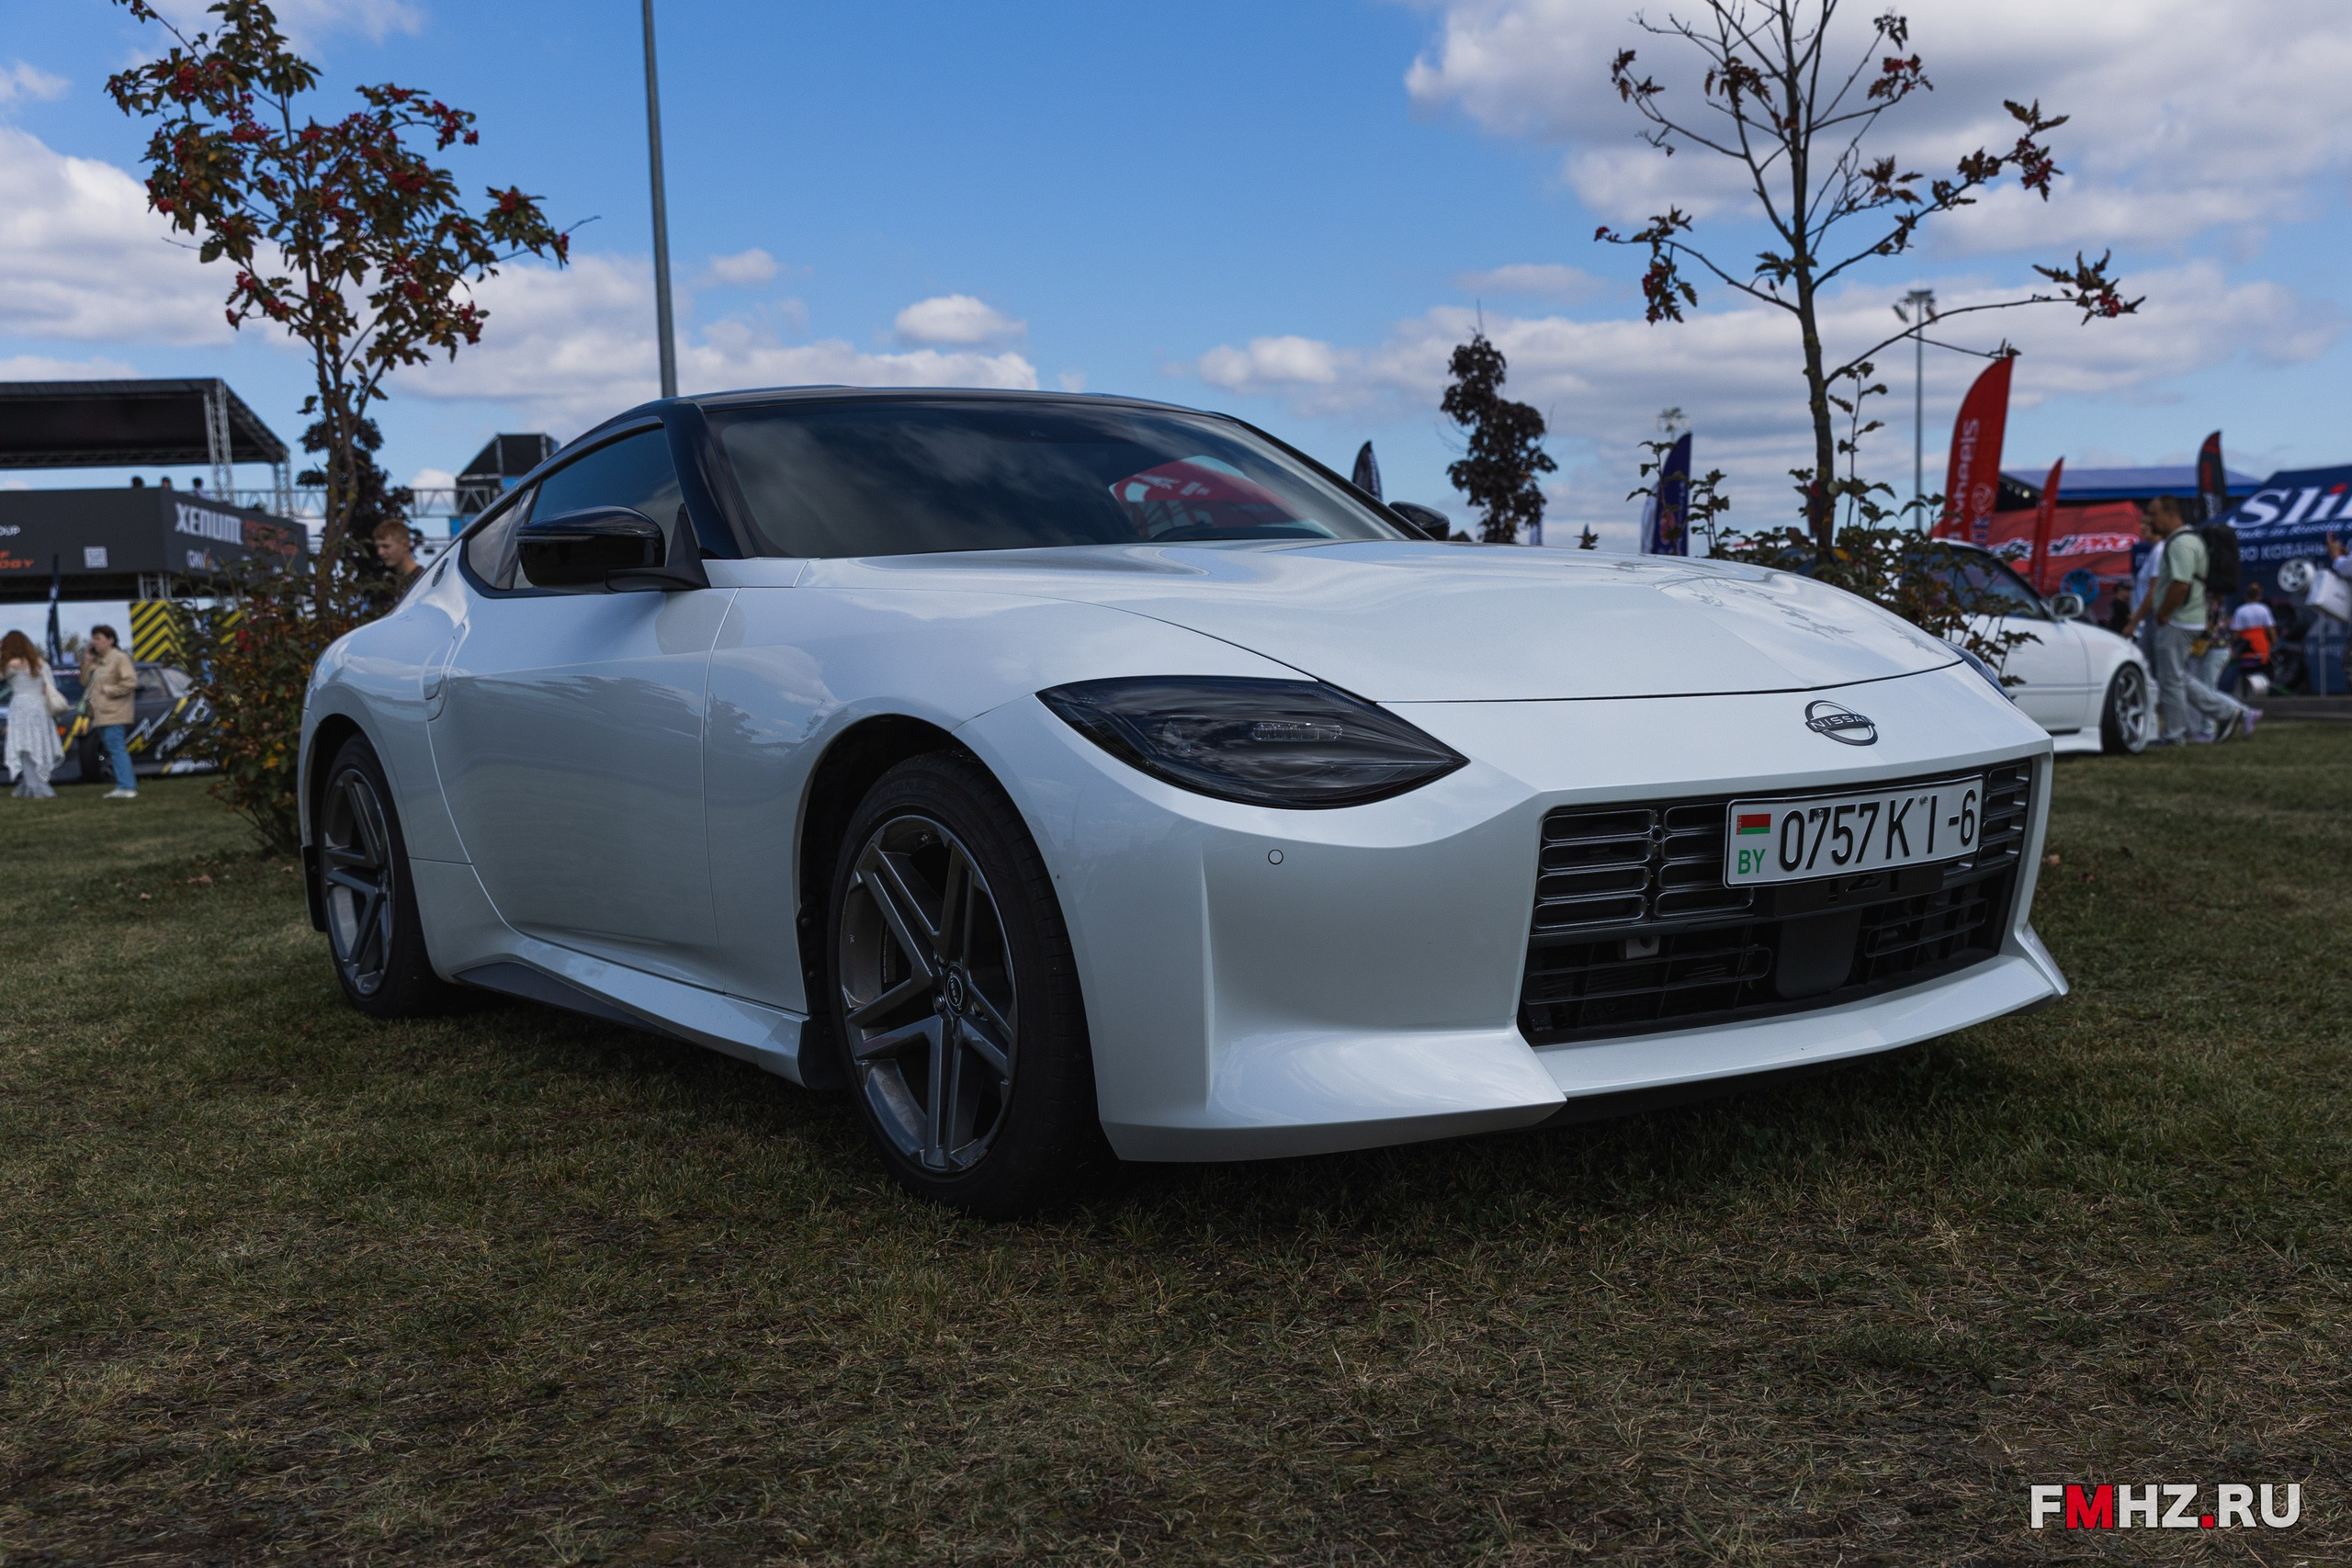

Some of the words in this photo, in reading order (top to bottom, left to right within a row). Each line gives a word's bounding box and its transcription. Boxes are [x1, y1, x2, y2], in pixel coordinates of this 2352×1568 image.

[175, 502, 243, 546] XENUM
[1809, 714, 1874, 730] NISSAN
[1779, 801, 1881, 872] 0757
[1737, 848, 1766, 874] BY
